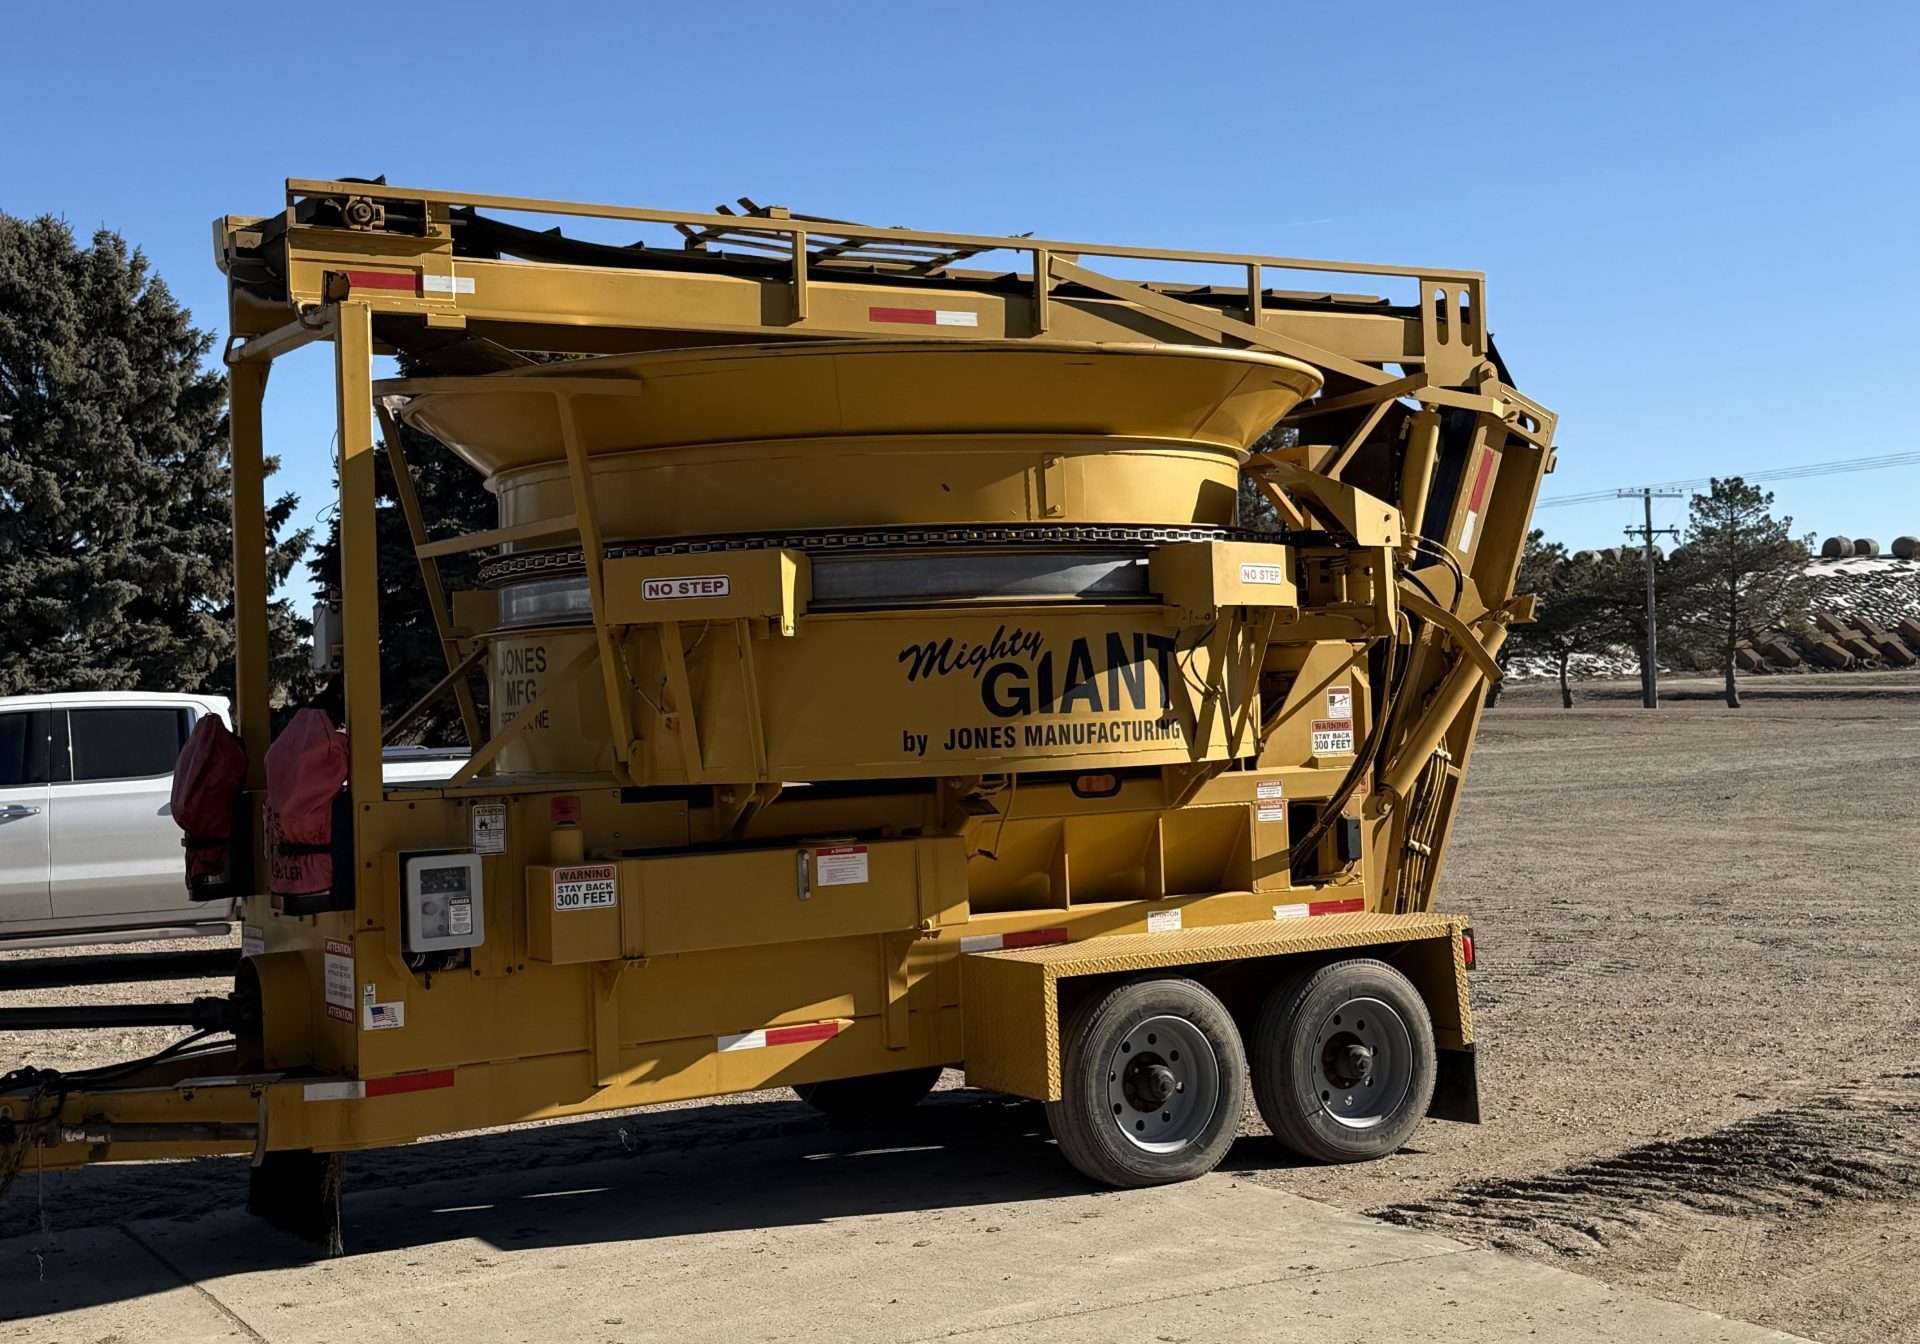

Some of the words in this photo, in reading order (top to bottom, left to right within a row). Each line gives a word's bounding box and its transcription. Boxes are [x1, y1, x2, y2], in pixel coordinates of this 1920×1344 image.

[1243, 569, 1257, 580] NO
[1260, 569, 1279, 581] STEP
[648, 583, 673, 597] NO
[678, 580, 725, 595] STEP
[501, 646, 547, 676] JONES
[899, 625, 1043, 682] Mighty
[981, 631, 1178, 718] GIANT
[506, 679, 537, 707] MFG
[1314, 721, 1350, 731] WARNING
[903, 730, 928, 756] by
[944, 726, 1016, 750] JONES
[1024, 717, 1180, 748] MANUFACTURING
[1314, 733, 1330, 741] STAY
[1332, 732, 1350, 740] BACK
[1314, 740, 1329, 750] 300
[1331, 739, 1351, 749] FEET
[559, 868, 611, 881] WARNING
[557, 884, 583, 894] STAY
[585, 881, 613, 892] BACK
[557, 893, 579, 906] 300
[583, 890, 614, 905] FEET
[326, 941, 352, 956] ATTENTION
[327, 1005, 353, 1022] ATTENTION
